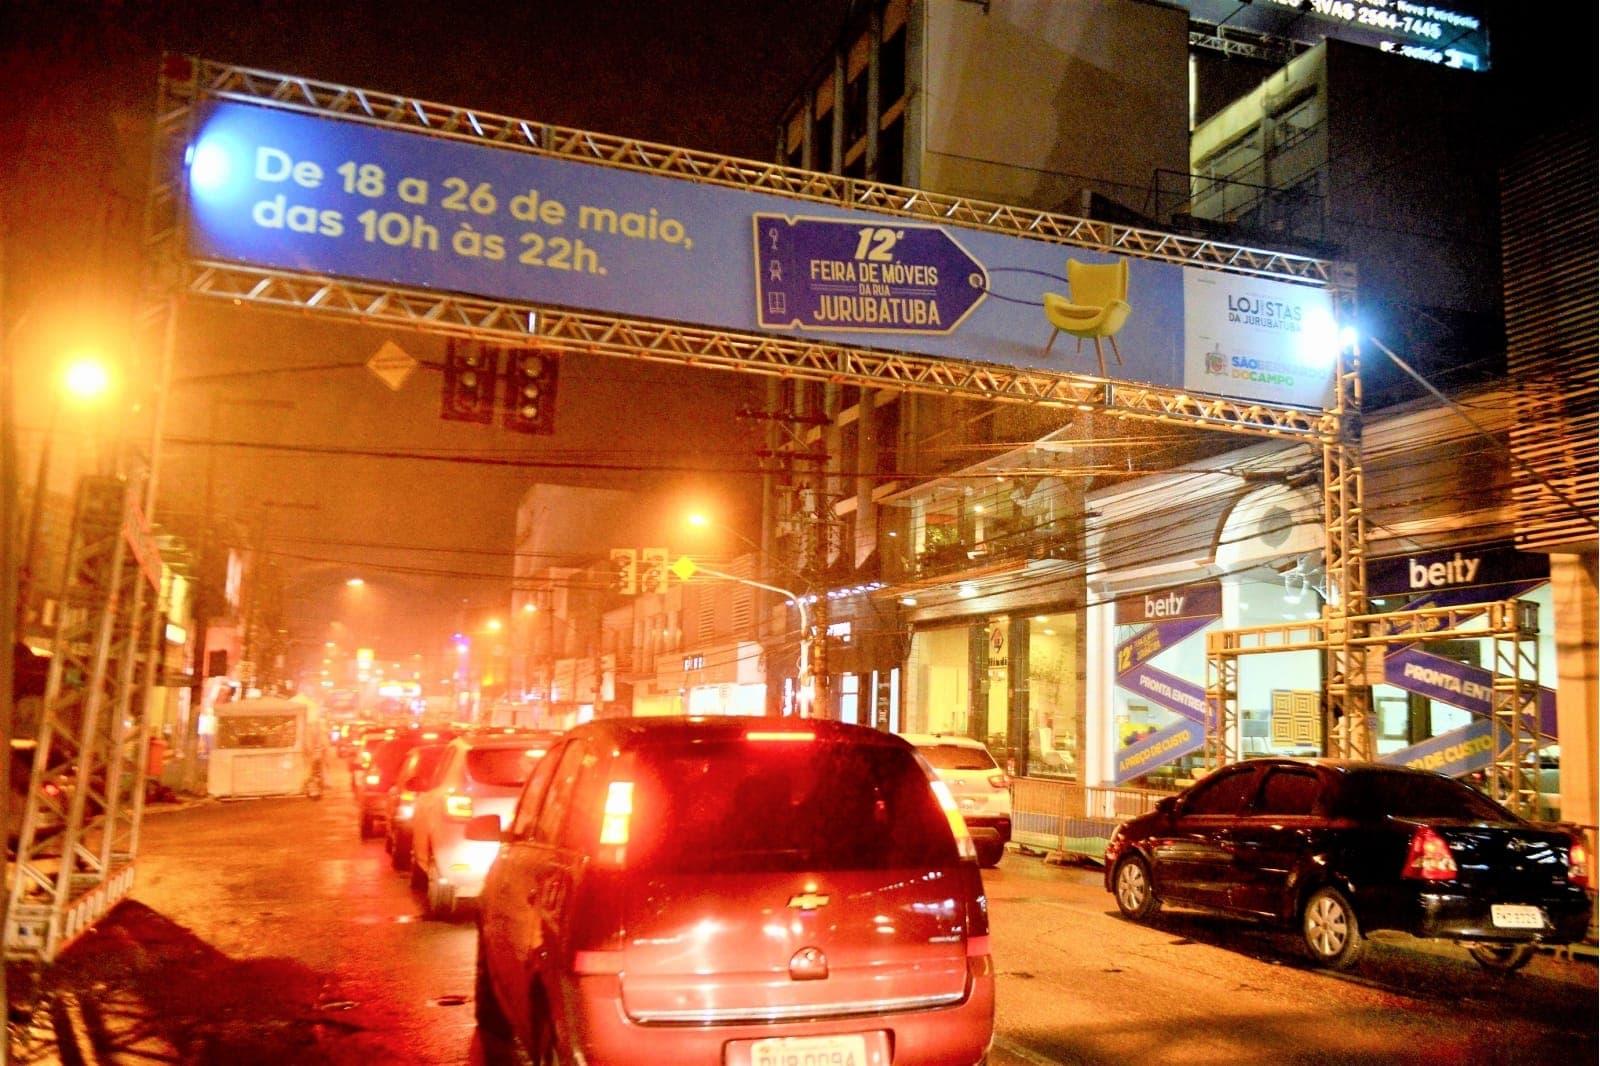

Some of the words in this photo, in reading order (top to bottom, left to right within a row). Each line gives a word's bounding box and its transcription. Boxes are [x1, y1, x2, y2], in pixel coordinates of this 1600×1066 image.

[254, 146, 323, 189] De
[337, 160, 386, 198] 18
[398, 177, 429, 205] a
[441, 175, 497, 216] 26
[509, 189, 566, 226] de
[578, 205, 695, 250] maio,
[252, 194, 345, 239] das
[358, 209, 440, 252] 10h
[452, 223, 506, 261] às
[518, 231, 609, 276] 22h.
[810, 260, 855, 282] FEIRA
[859, 262, 880, 284] DE
[882, 260, 938, 285] MÓVEIS
[858, 283, 872, 296] DA
[872, 284, 890, 296] RUA
[813, 296, 941, 324] JURUBATUBA
[1228, 312, 1241, 323] DA
[1403, 662, 1461, 692] PRONTA
[1139, 674, 1172, 699] PRONTA
[1172, 688, 1213, 717] ENTREG
[1443, 734, 1494, 763] CUSTO
